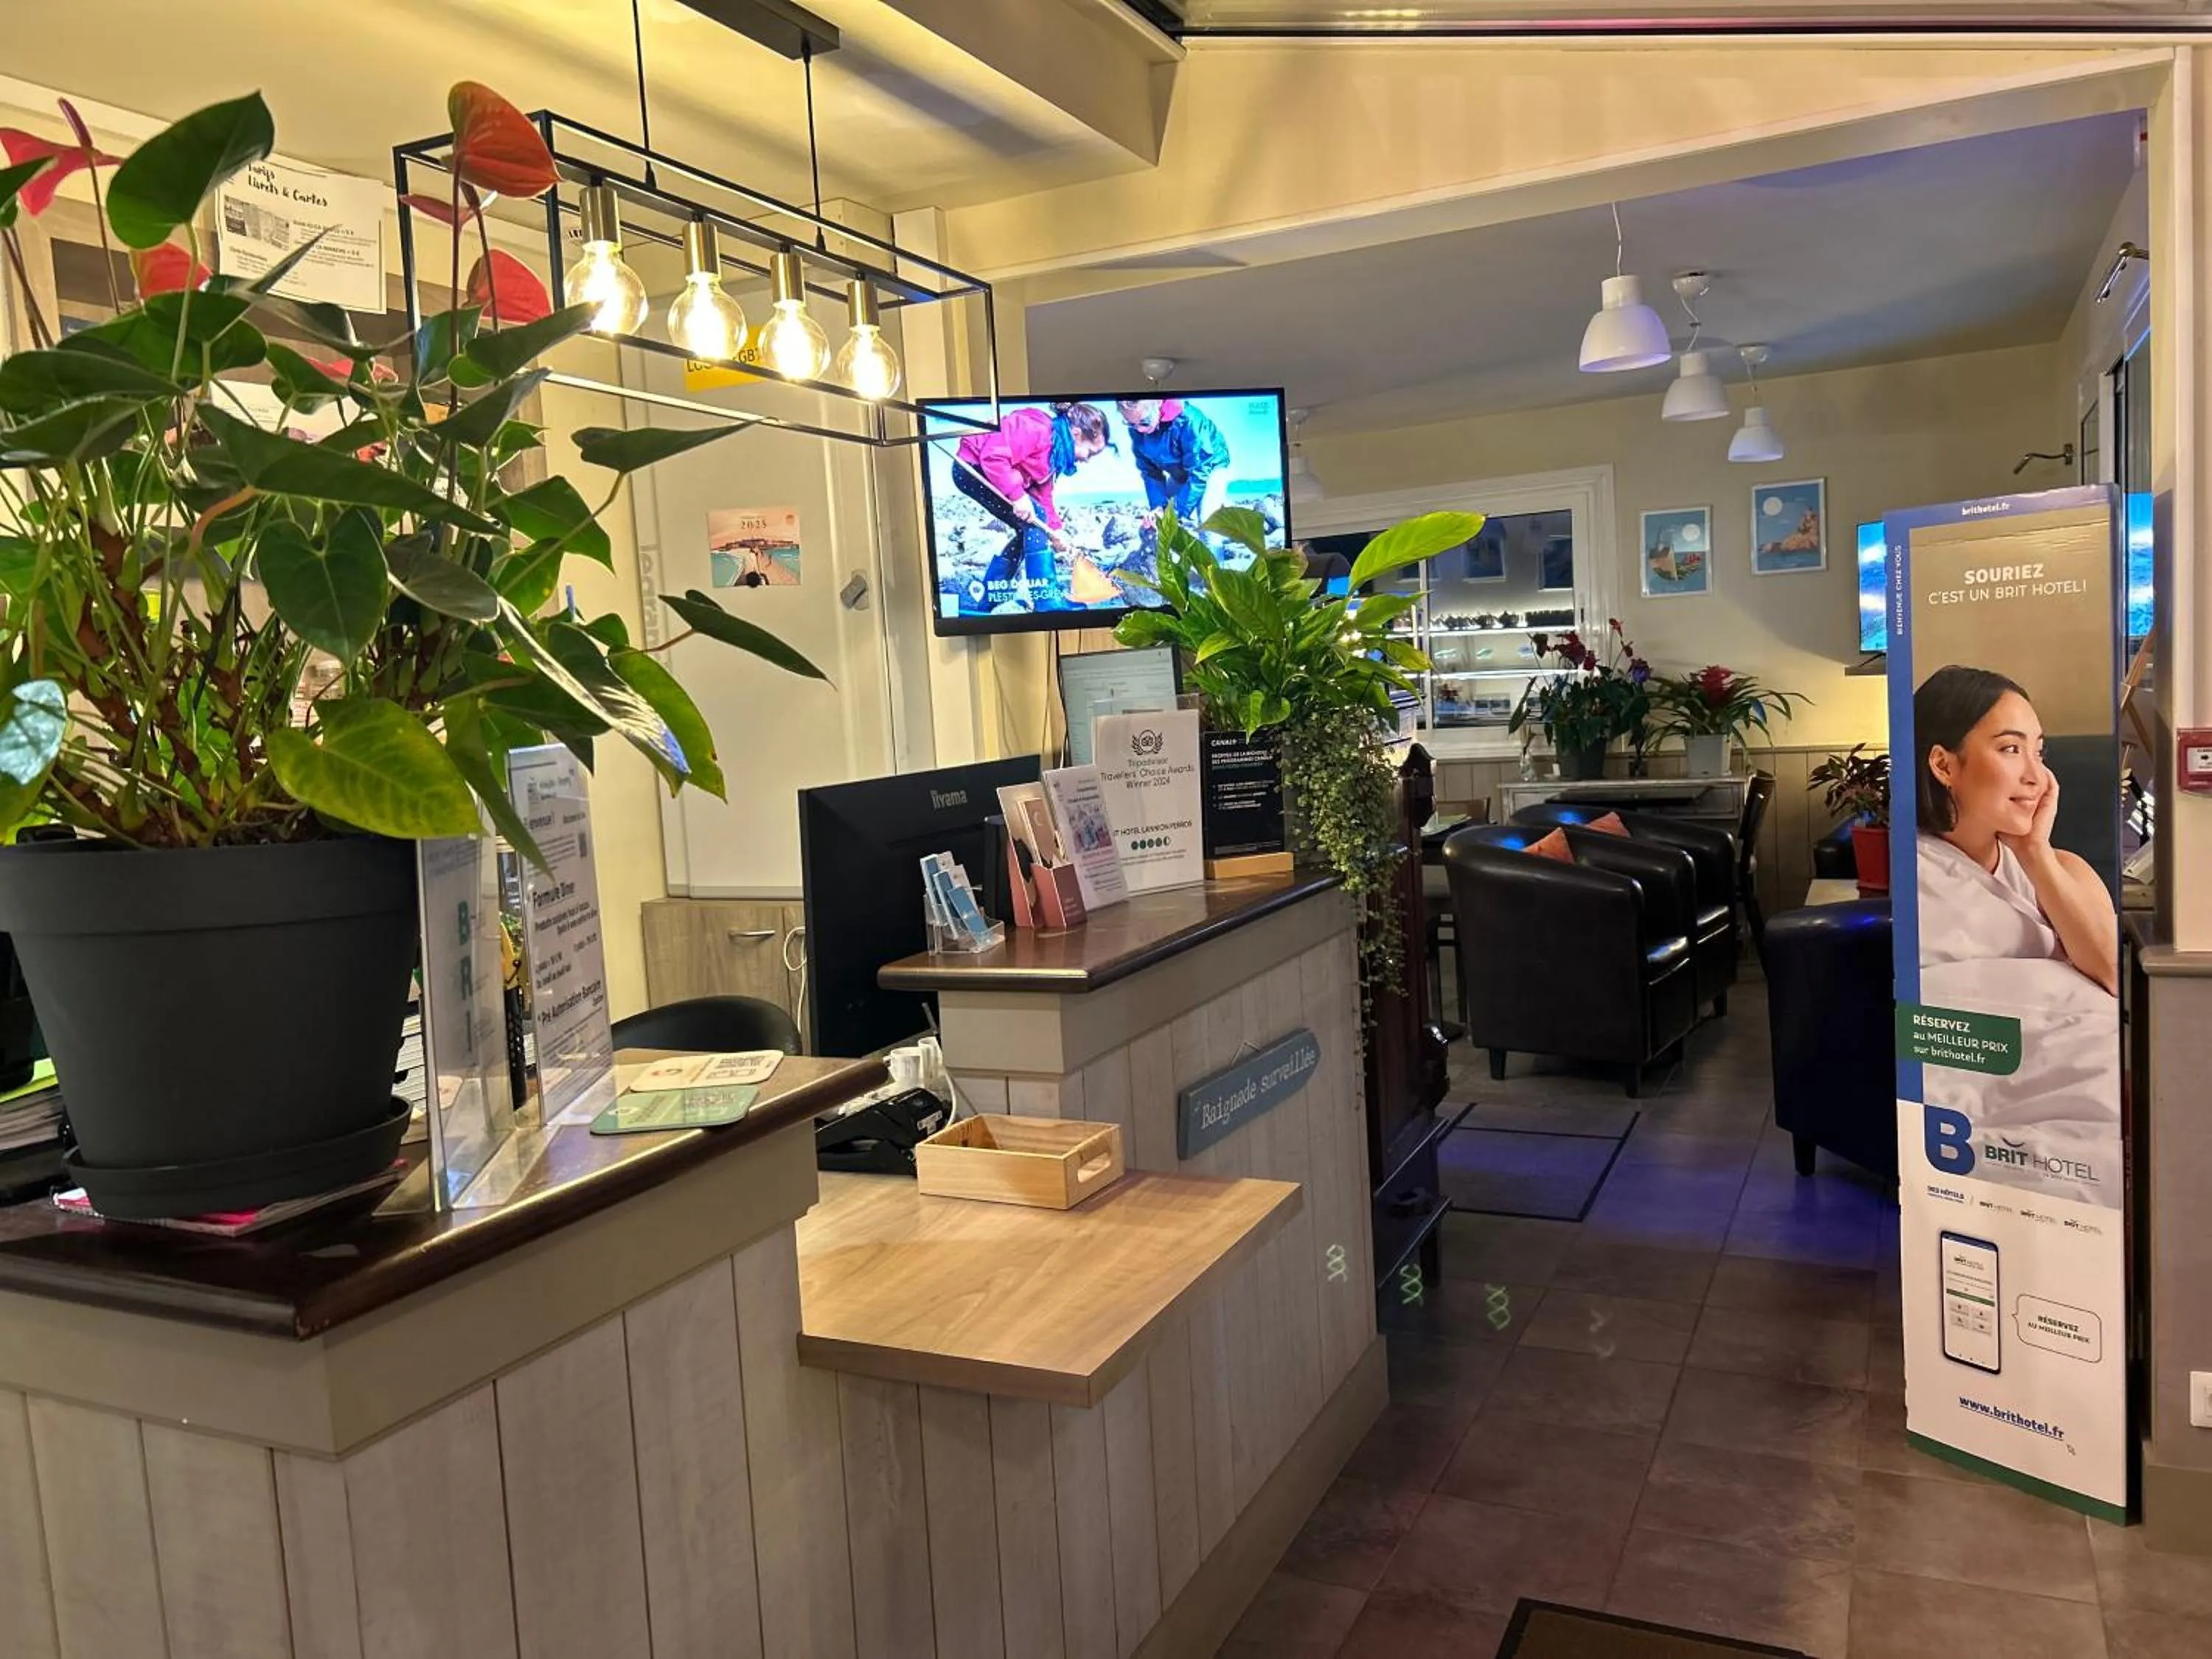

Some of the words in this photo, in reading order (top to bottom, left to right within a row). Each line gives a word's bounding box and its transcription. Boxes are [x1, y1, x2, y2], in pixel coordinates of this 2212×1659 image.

[293, 189, 329, 208] Cartes
[740, 519, 768, 530] 2025
[1964, 563, 2045, 585] SOURIEZ
[1928, 590, 1966, 605] C'EST
[1969, 588, 1990, 602] UN
[1995, 585, 2028, 599] BRIT
[1139, 768, 1166, 778] Choice
[1167, 763, 1195, 775] Awards
[931, 790, 967, 809] iiyama
[1121, 827, 1141, 837] HOTEL
[1913, 1014, 1971, 1033] RÉSERVEZ
[1913, 1032, 1926, 1040] au
[1927, 1032, 1980, 1049] MEILLEUR
[1981, 1040, 2008, 1054] PRIX
[1913, 1046, 1929, 1054] sur
[1931, 1045, 1986, 1064] brithotel.fr
[1201, 1077, 1257, 1130] Baignade
[1260, 1045, 1317, 1093] surveillée
[1924, 1105, 1976, 1176] B
[1984, 1144, 2028, 1166] BRIT
[2033, 1152, 2101, 1182] HOTEL
[2028, 1321, 2037, 1329] AU
[2039, 1325, 2072, 1338] MEILLEUR
[2037, 1315, 2079, 1332] RÉSERVEZ
[1958, 1395, 2065, 1440] www.brithotel.fr
